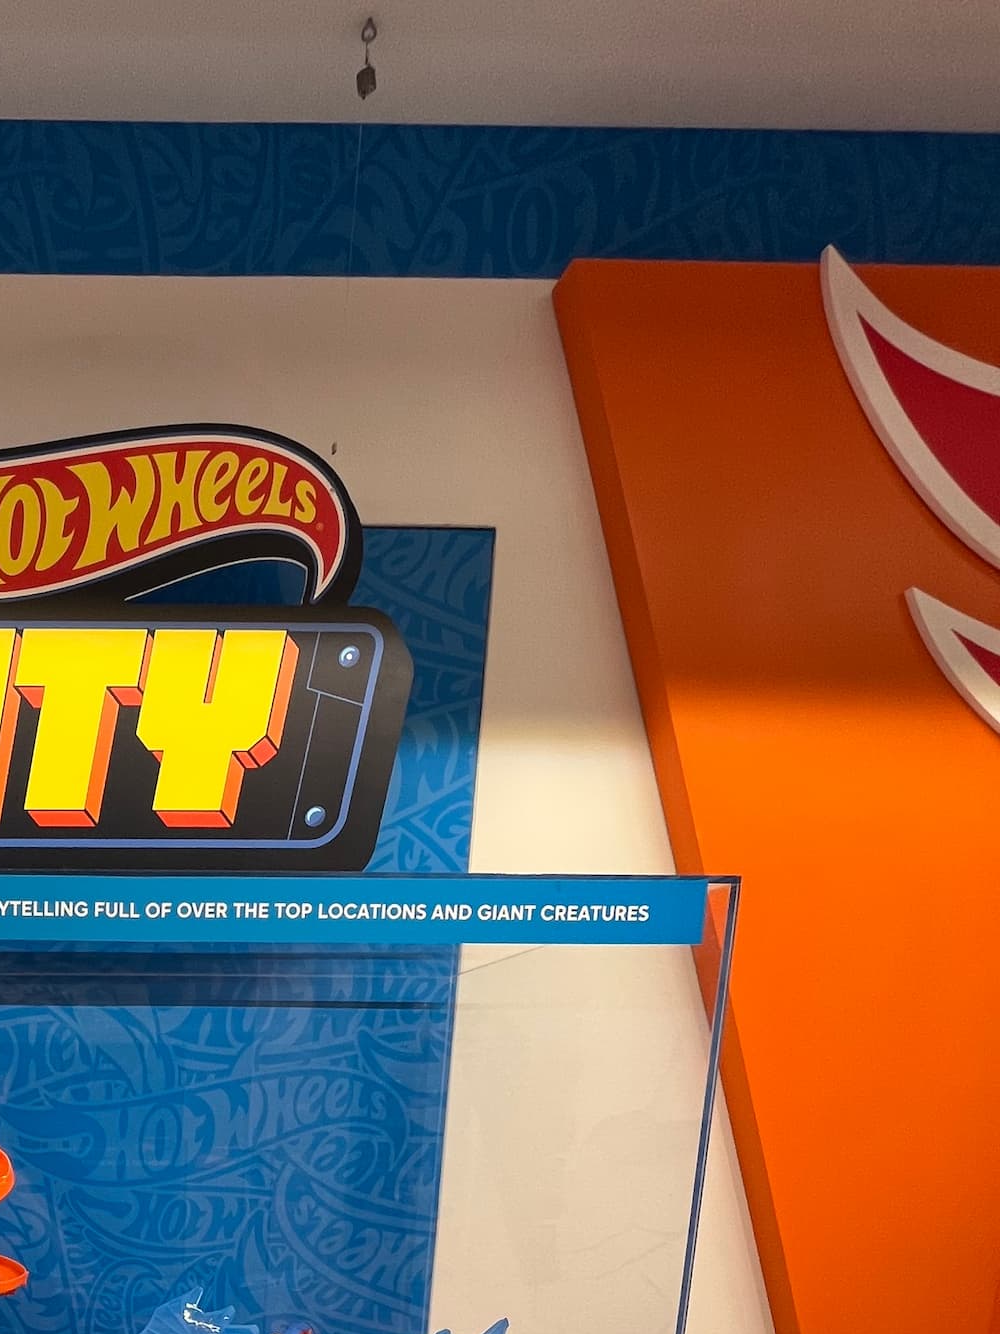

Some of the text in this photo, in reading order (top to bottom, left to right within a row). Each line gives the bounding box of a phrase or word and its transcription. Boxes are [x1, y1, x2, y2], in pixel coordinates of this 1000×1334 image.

[94, 901, 140, 918] FULL
[146, 902, 172, 919] OF
[176, 902, 228, 919] OVER
[233, 902, 270, 919] THE
[274, 903, 313, 919] TOP
[317, 903, 428, 920] LOCATIONS
[431, 904, 472, 920] AND
[476, 904, 536, 921] GIANT
[540, 905, 650, 922] CREATURES
